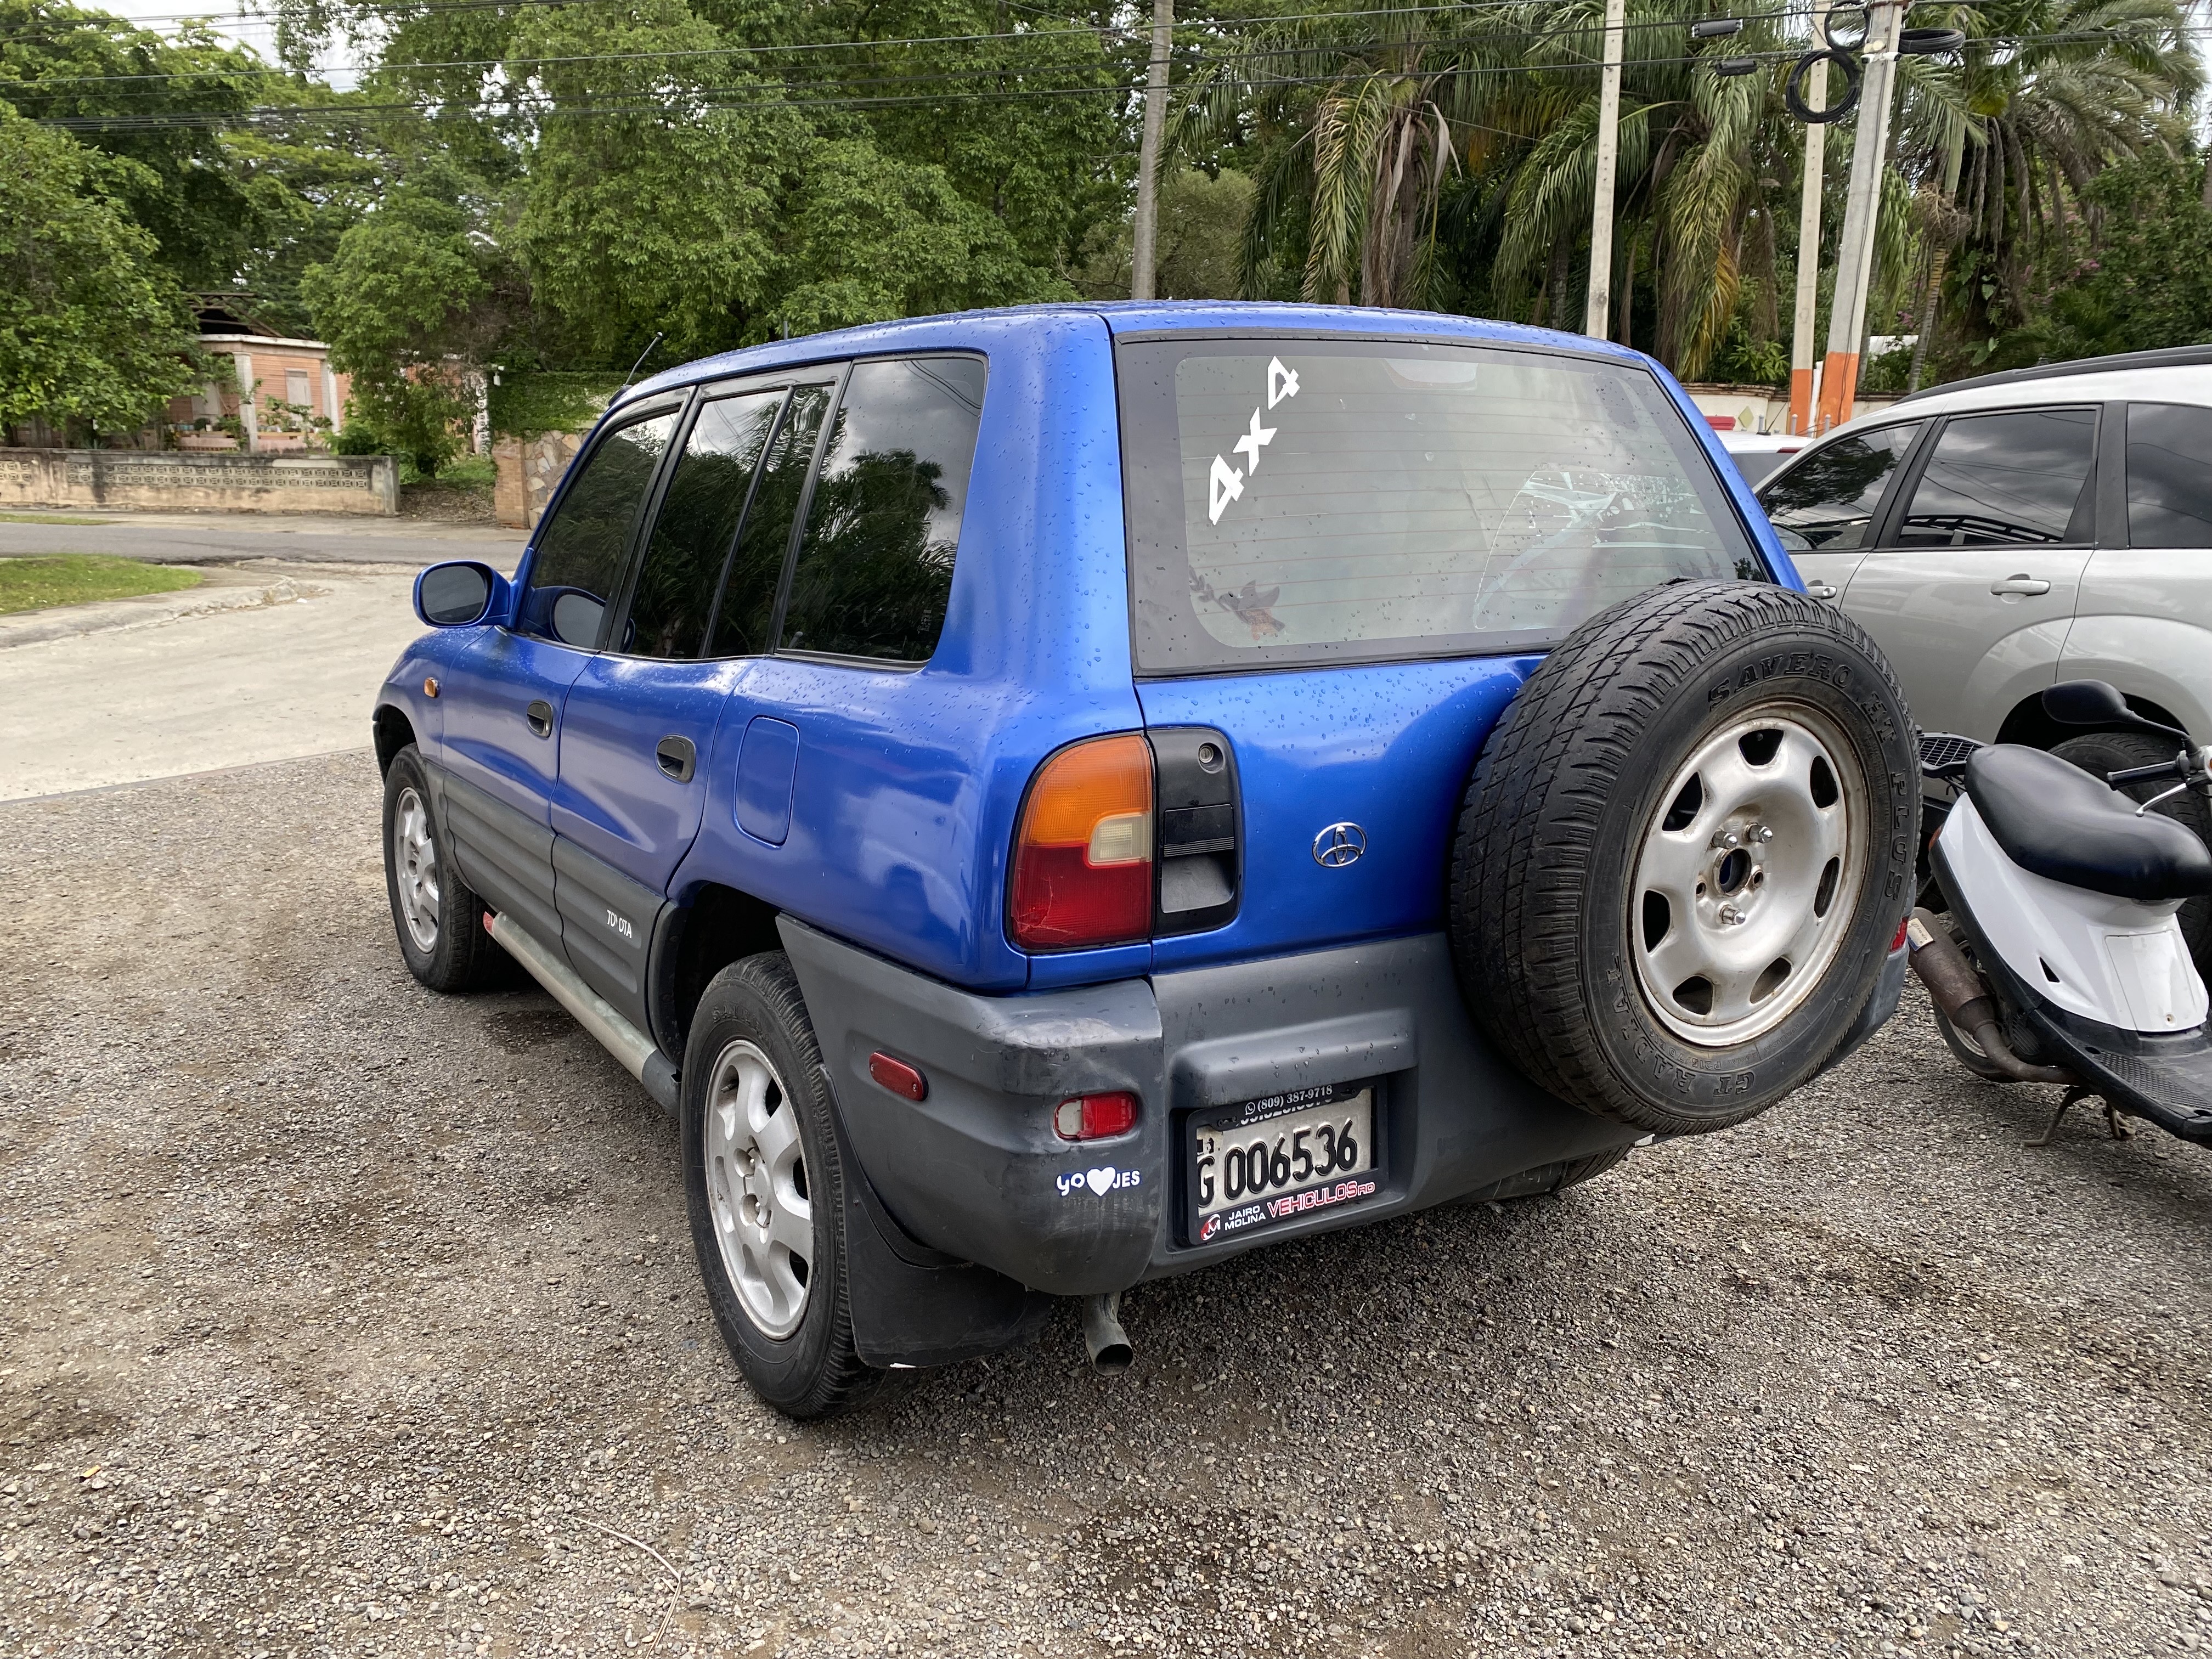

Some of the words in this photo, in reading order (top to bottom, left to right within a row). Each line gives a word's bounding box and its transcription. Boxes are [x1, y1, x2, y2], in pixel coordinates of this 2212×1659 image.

[1708, 652, 1854, 709] SAVERO
[1862, 691, 1898, 744] HT
[1884, 771, 1910, 901] PLUS
[1668, 1047, 1722, 1070] P215/70
[1713, 1070, 1755, 1096] GT
[1257, 1096, 1284, 1113] (809)
[1286, 1085, 1333, 1104] 387-9718
[1112, 1170, 1140, 1189] JES
[1224, 1212, 1266, 1231] MOLINA
[1228, 1205, 1260, 1221] JAIRO
